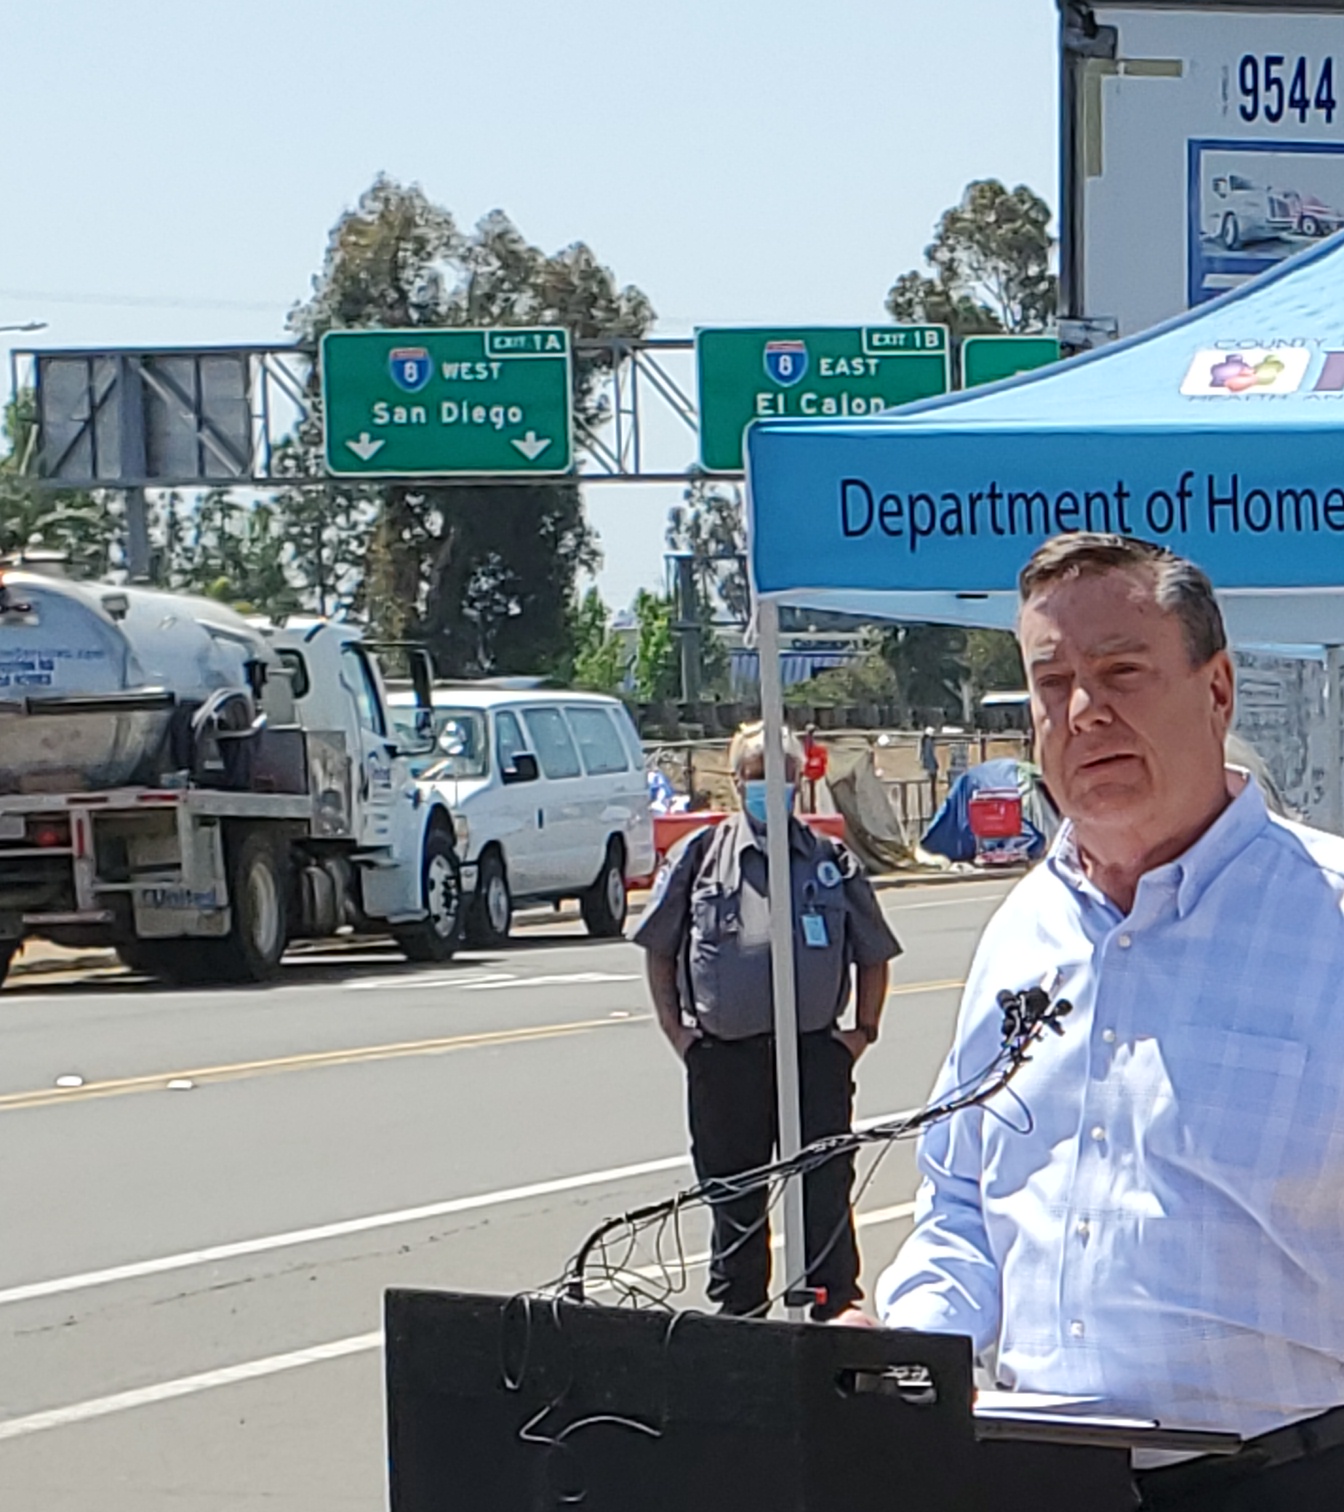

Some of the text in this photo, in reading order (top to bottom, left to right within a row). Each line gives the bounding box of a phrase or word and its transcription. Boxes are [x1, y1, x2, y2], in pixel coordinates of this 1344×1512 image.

[1239, 54, 1336, 124] 9544
[533, 334, 562, 351] 1A
[872, 330, 940, 348] EXIT 1B
[1213, 337, 1328, 350] COUNTY
[403, 361, 502, 383] 8 WEST
[778, 355, 880, 376] 8 EAST
[756, 392, 886, 416] El Cajon
[372, 401, 523, 430] San Diego
[840, 476, 1132, 554] Department
[1147, 470, 1195, 534] of
